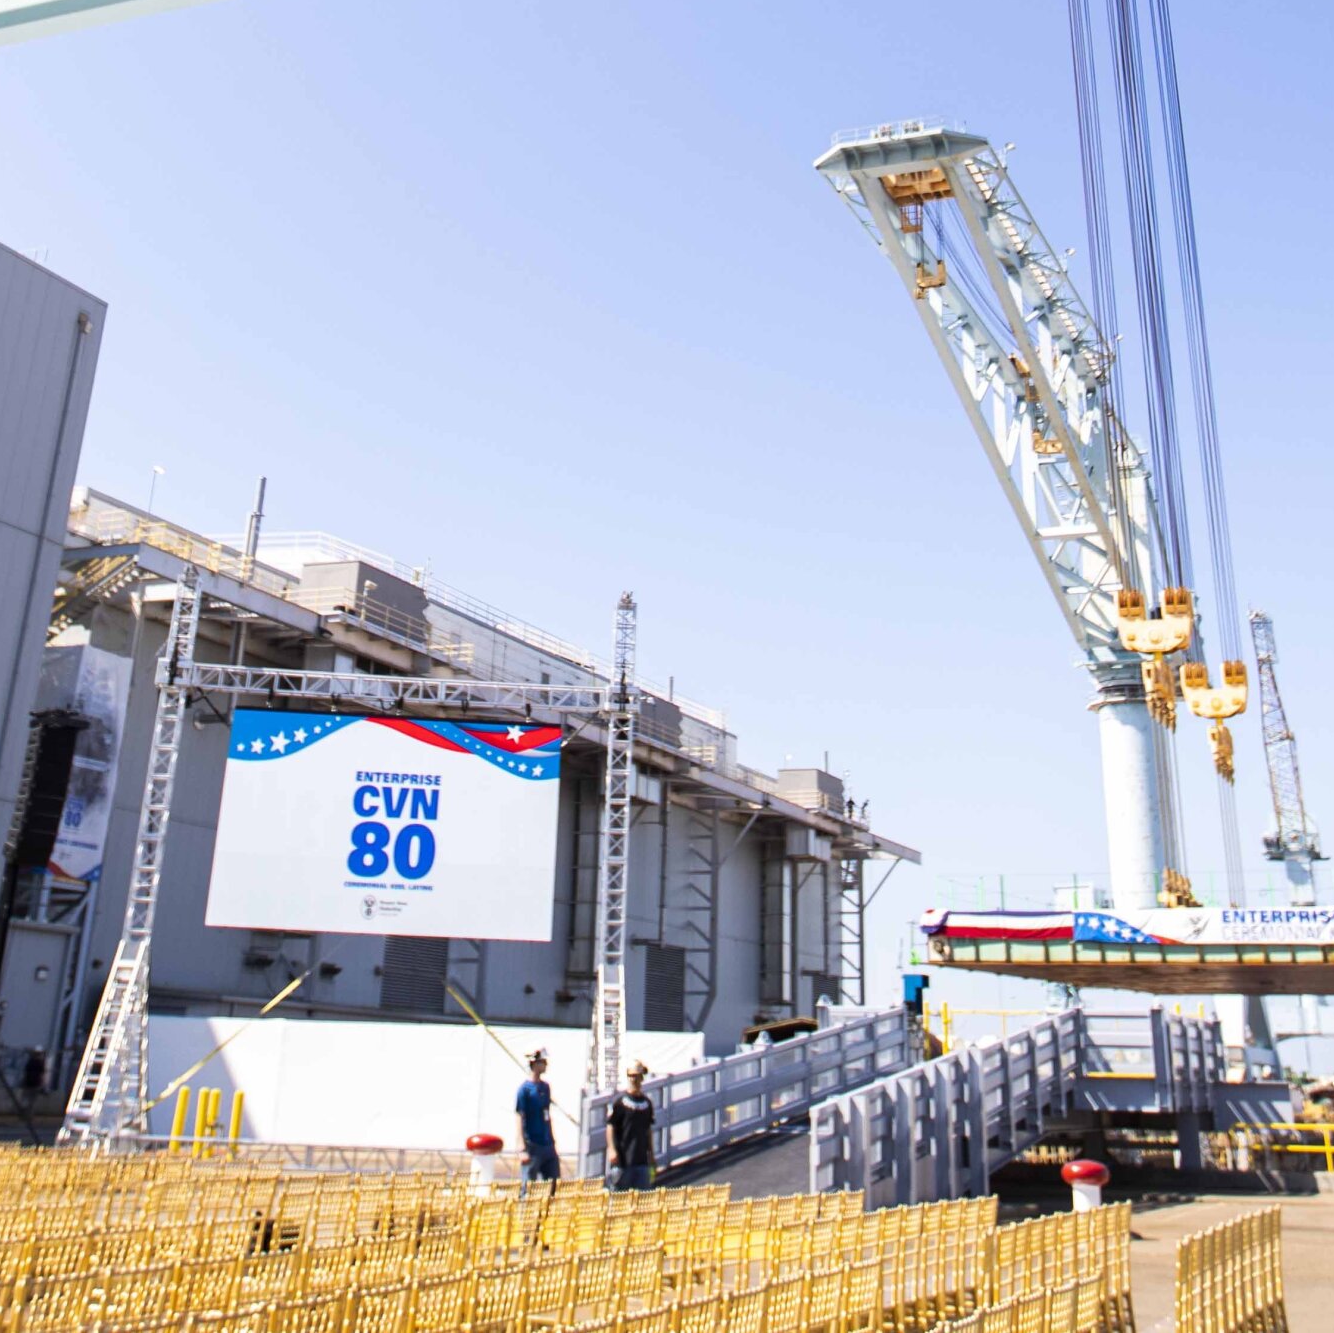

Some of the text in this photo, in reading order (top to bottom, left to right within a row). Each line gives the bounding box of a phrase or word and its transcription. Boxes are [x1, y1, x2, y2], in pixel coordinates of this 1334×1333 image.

[355, 770, 442, 786] ENTERPRISE
[353, 784, 440, 820] CVN
[347, 821, 436, 881] 80
